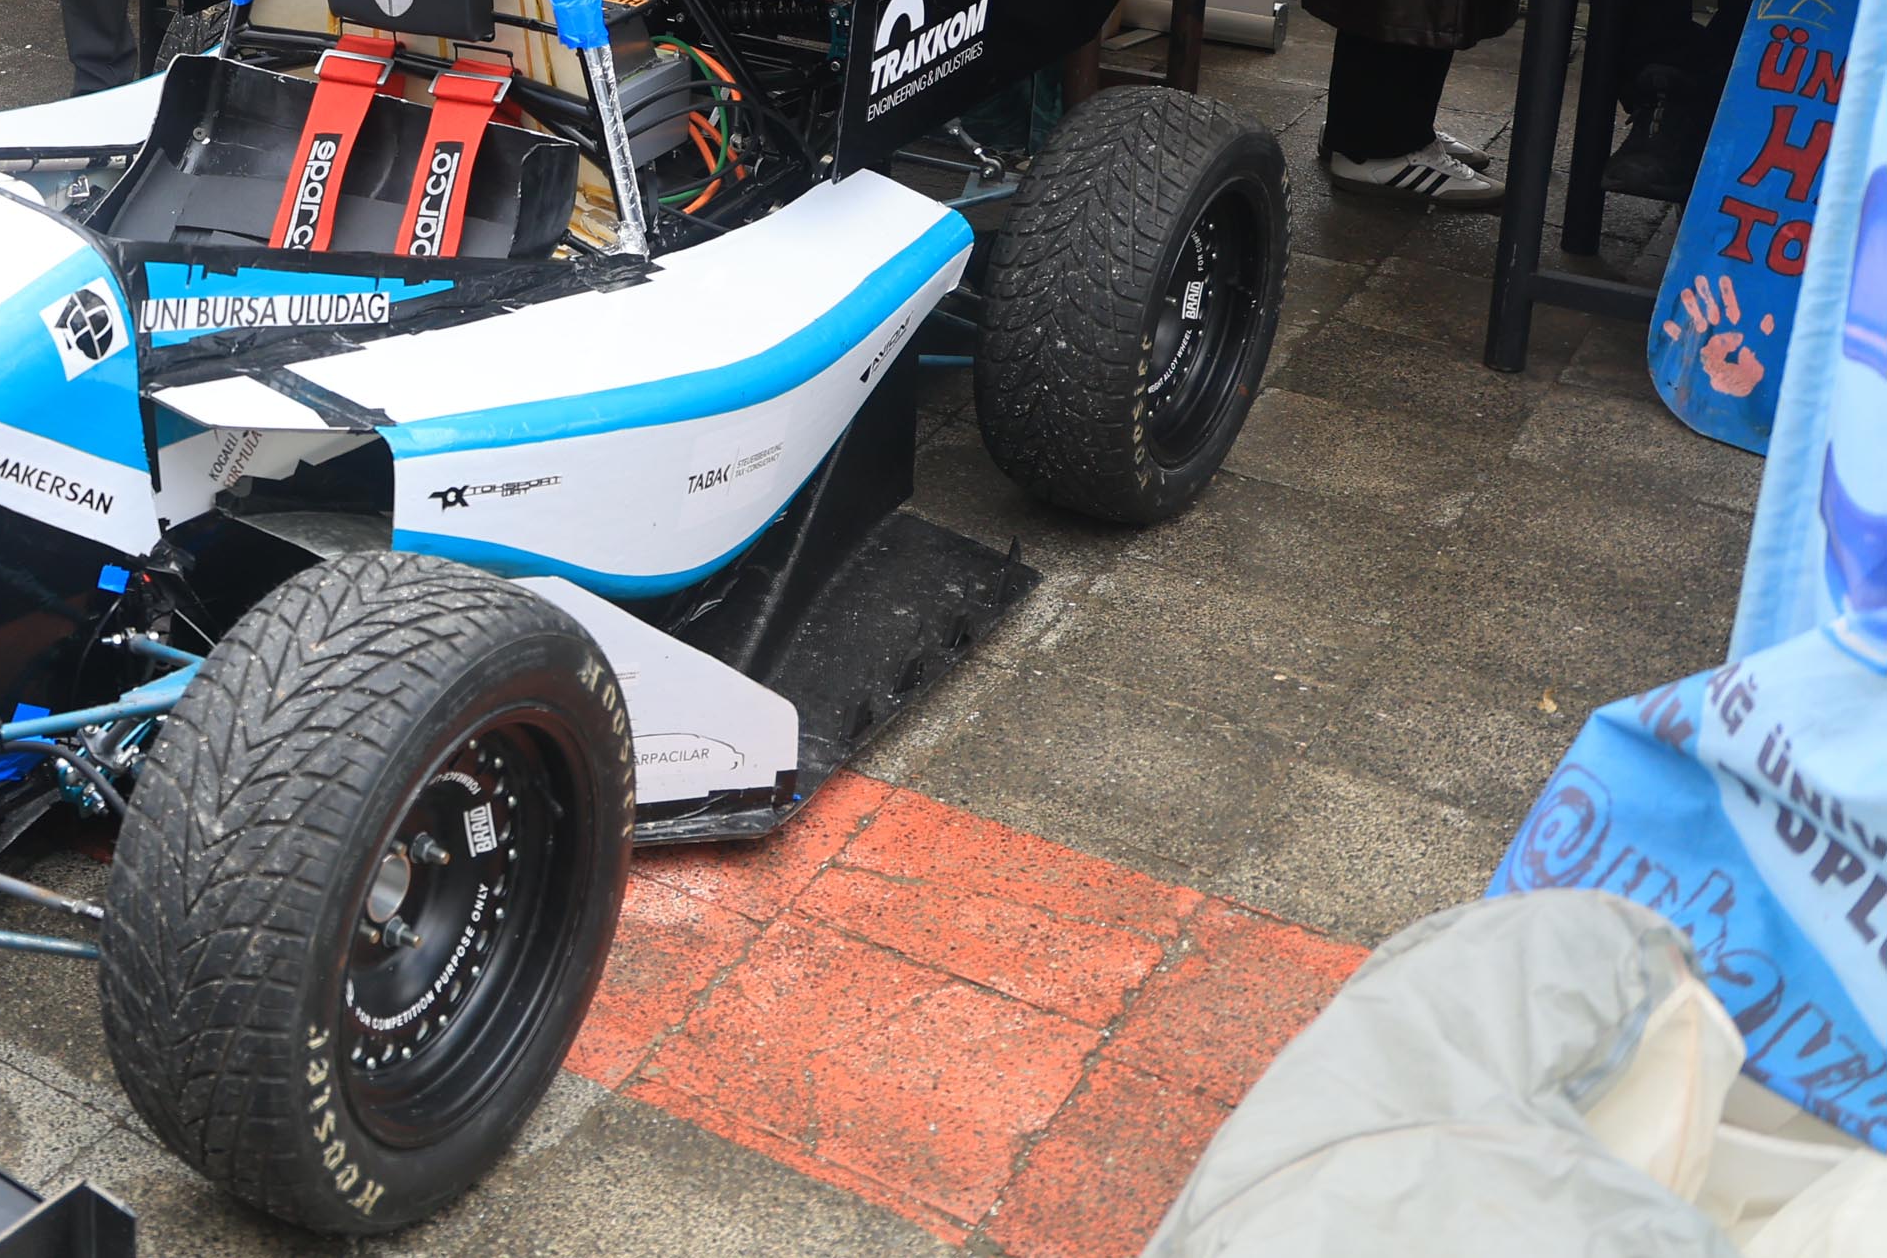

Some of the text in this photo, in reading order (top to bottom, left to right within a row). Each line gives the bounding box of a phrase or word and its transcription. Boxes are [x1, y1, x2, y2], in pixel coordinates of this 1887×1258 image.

[867, 40, 985, 123] ENGINEERING & INDUSTRIES
[284, 140, 338, 250] sparc
[410, 148, 462, 256] parco
[141, 293, 387, 331] UNI BURSA ULUDAG
[1185, 280, 1202, 320] BRAID
[1163, 356, 1178, 383] ALLOY
[1176, 329, 1193, 359] WHEEL
[469, 805, 494, 854] BRAID
[371, 990, 436, 1031] COMPETITION
[433, 924, 476, 994] PURPOSE
[472, 882, 490, 923] ONLY
